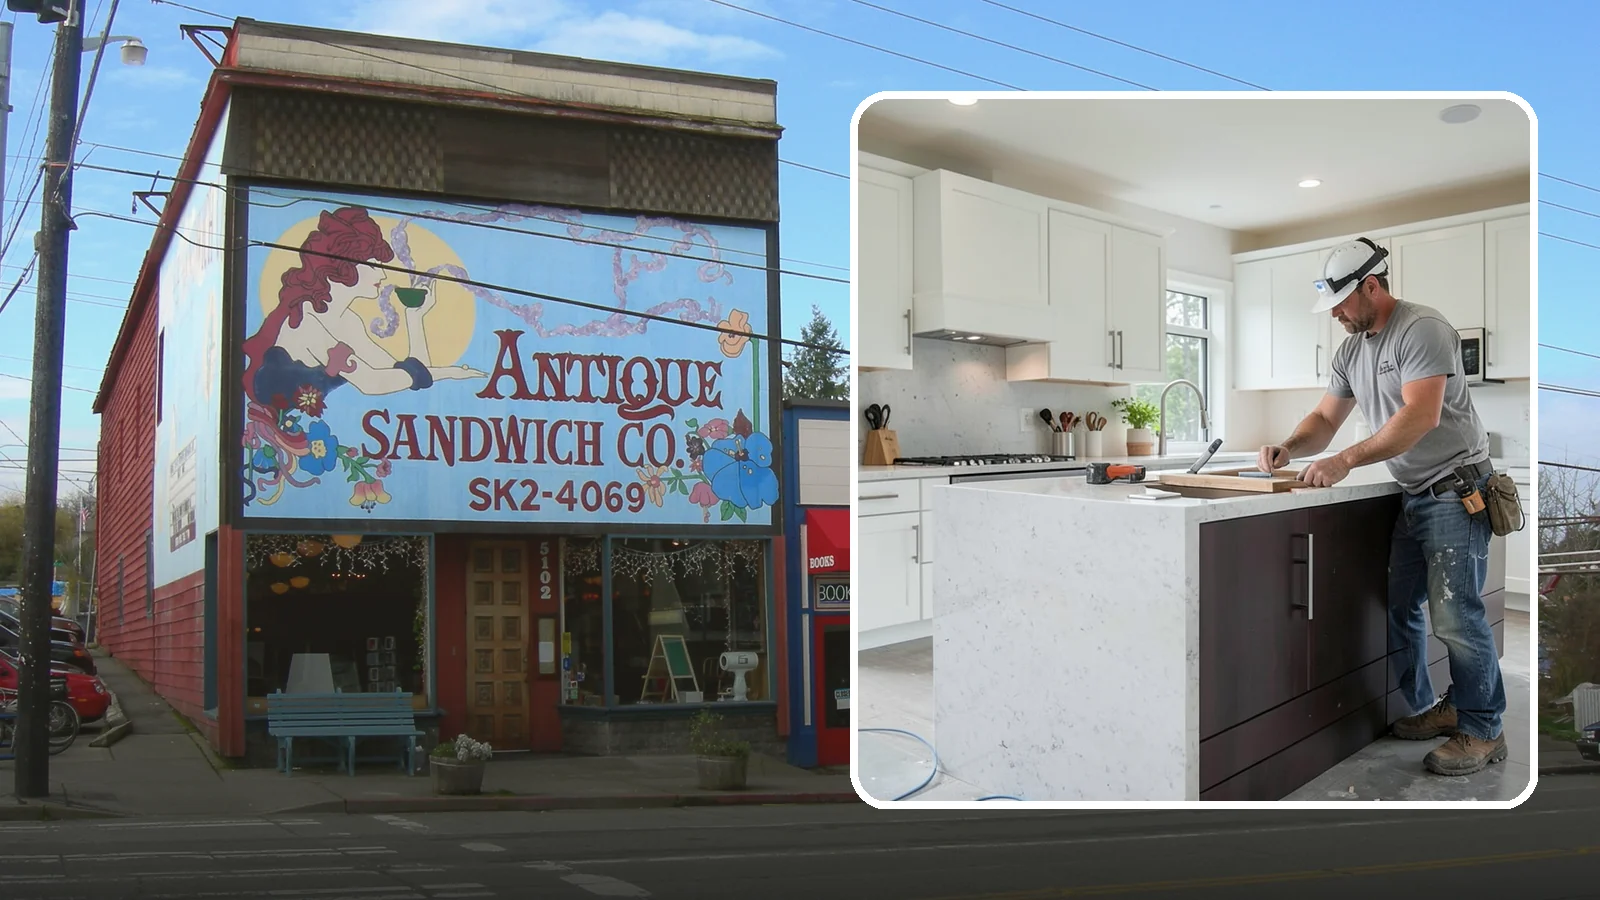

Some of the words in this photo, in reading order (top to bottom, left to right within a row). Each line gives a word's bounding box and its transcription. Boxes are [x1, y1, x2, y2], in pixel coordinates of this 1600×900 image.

[476, 329, 723, 420] ANTIQUE
[361, 409, 604, 467] SANDWICH
[617, 422, 685, 468] CO.
[469, 477, 645, 513] SK2-4069
[540, 541, 551, 600] 5102
[809, 555, 835, 569] BOOKS
